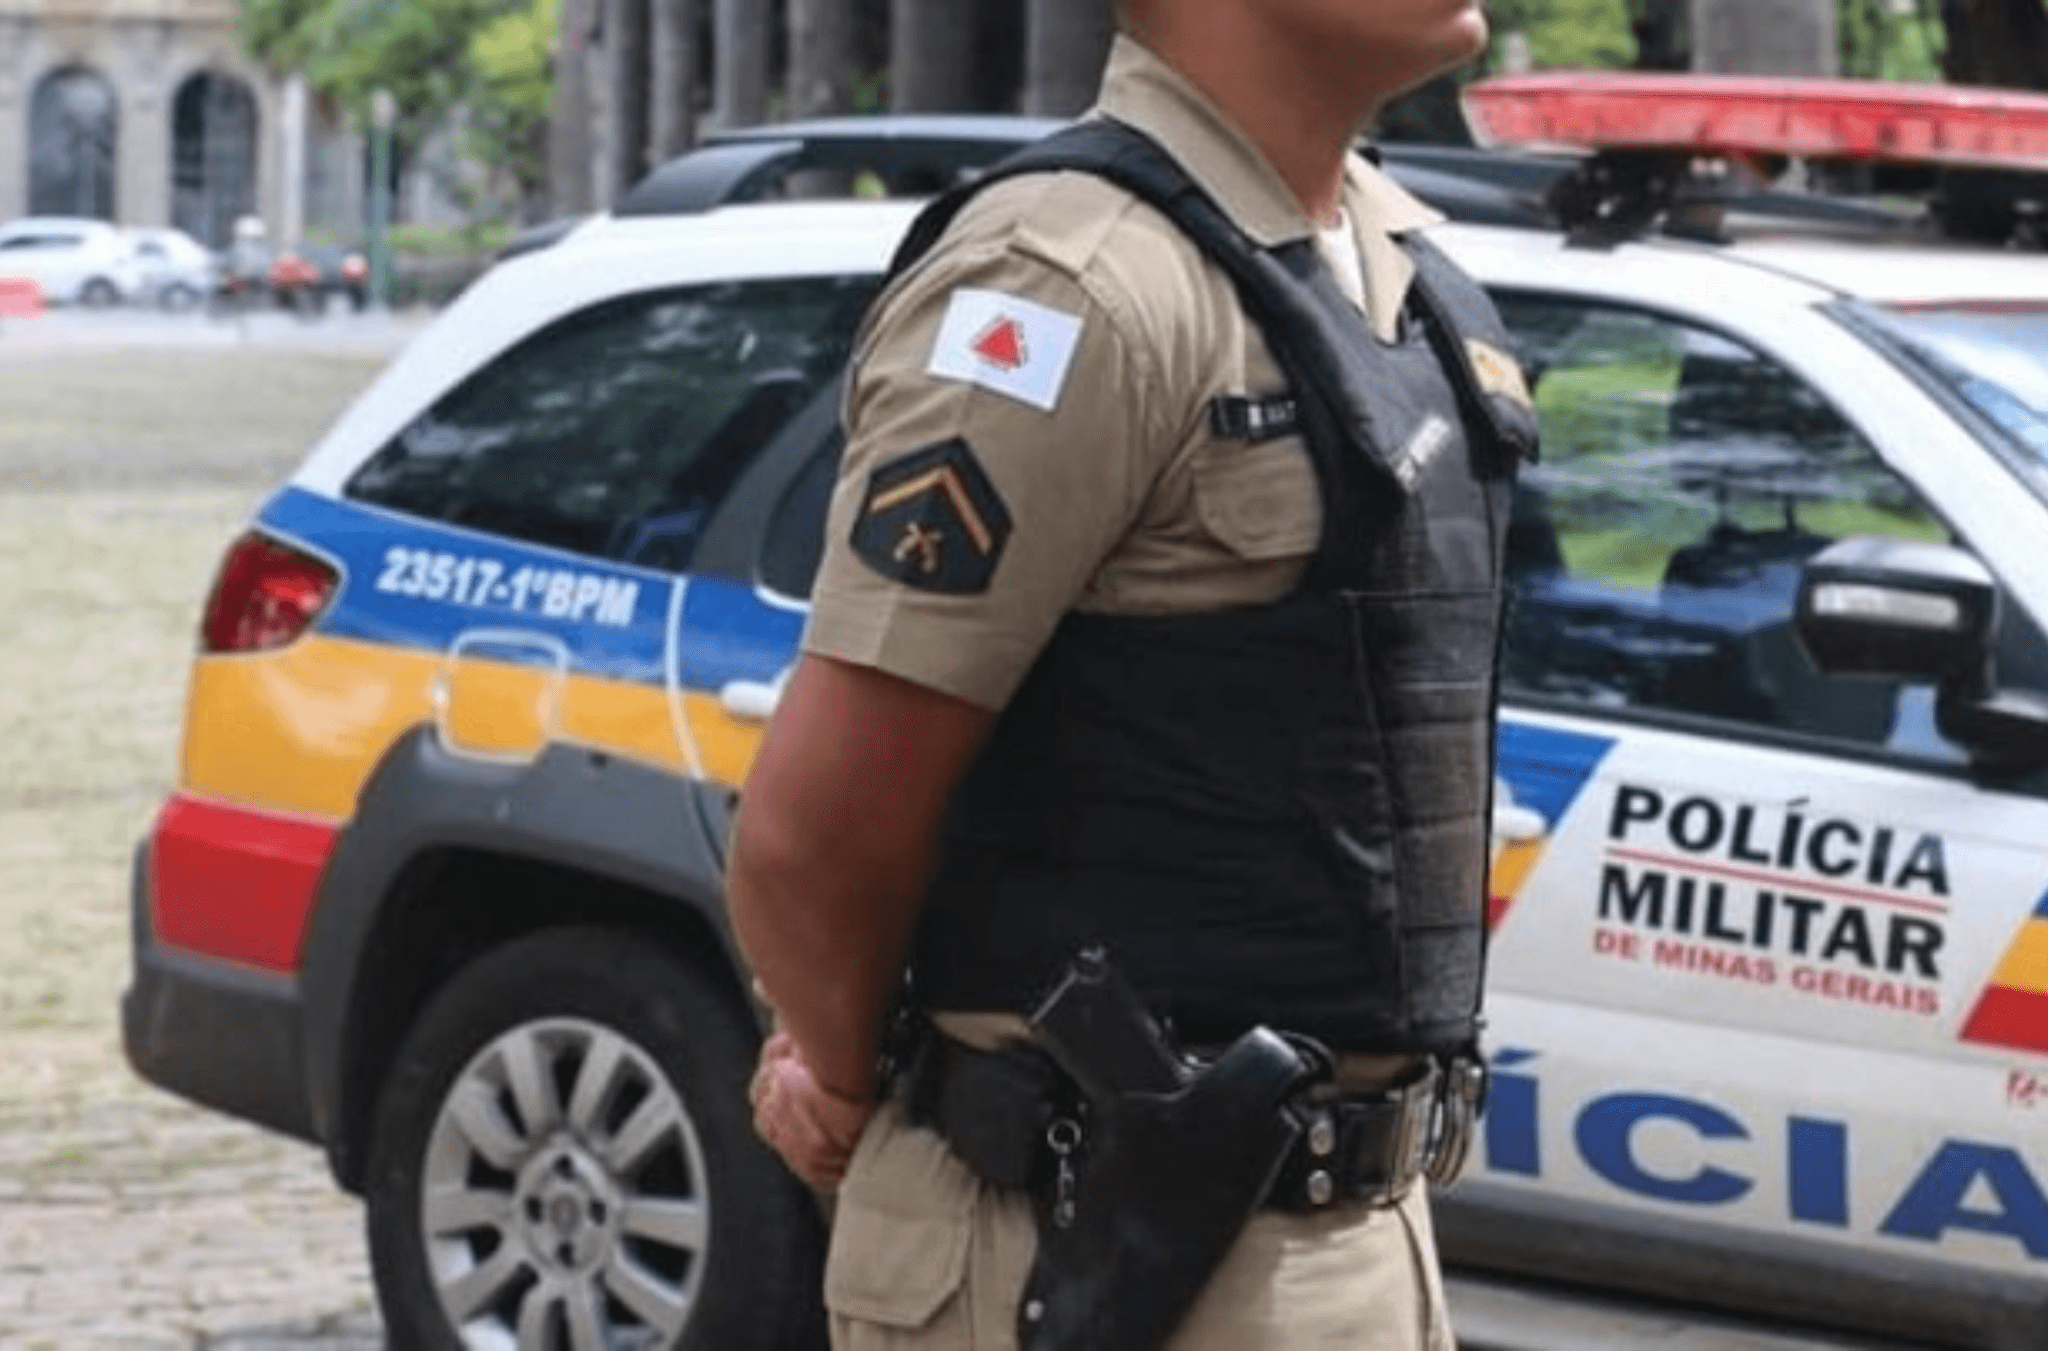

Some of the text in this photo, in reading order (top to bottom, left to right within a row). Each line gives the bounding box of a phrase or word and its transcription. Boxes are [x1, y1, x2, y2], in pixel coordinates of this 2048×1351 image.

[1609, 785, 1950, 896] POLÍCIA
[1594, 928, 1941, 1017] DE MINAS GERAIS
[1598, 863, 1945, 980] MILITAR
